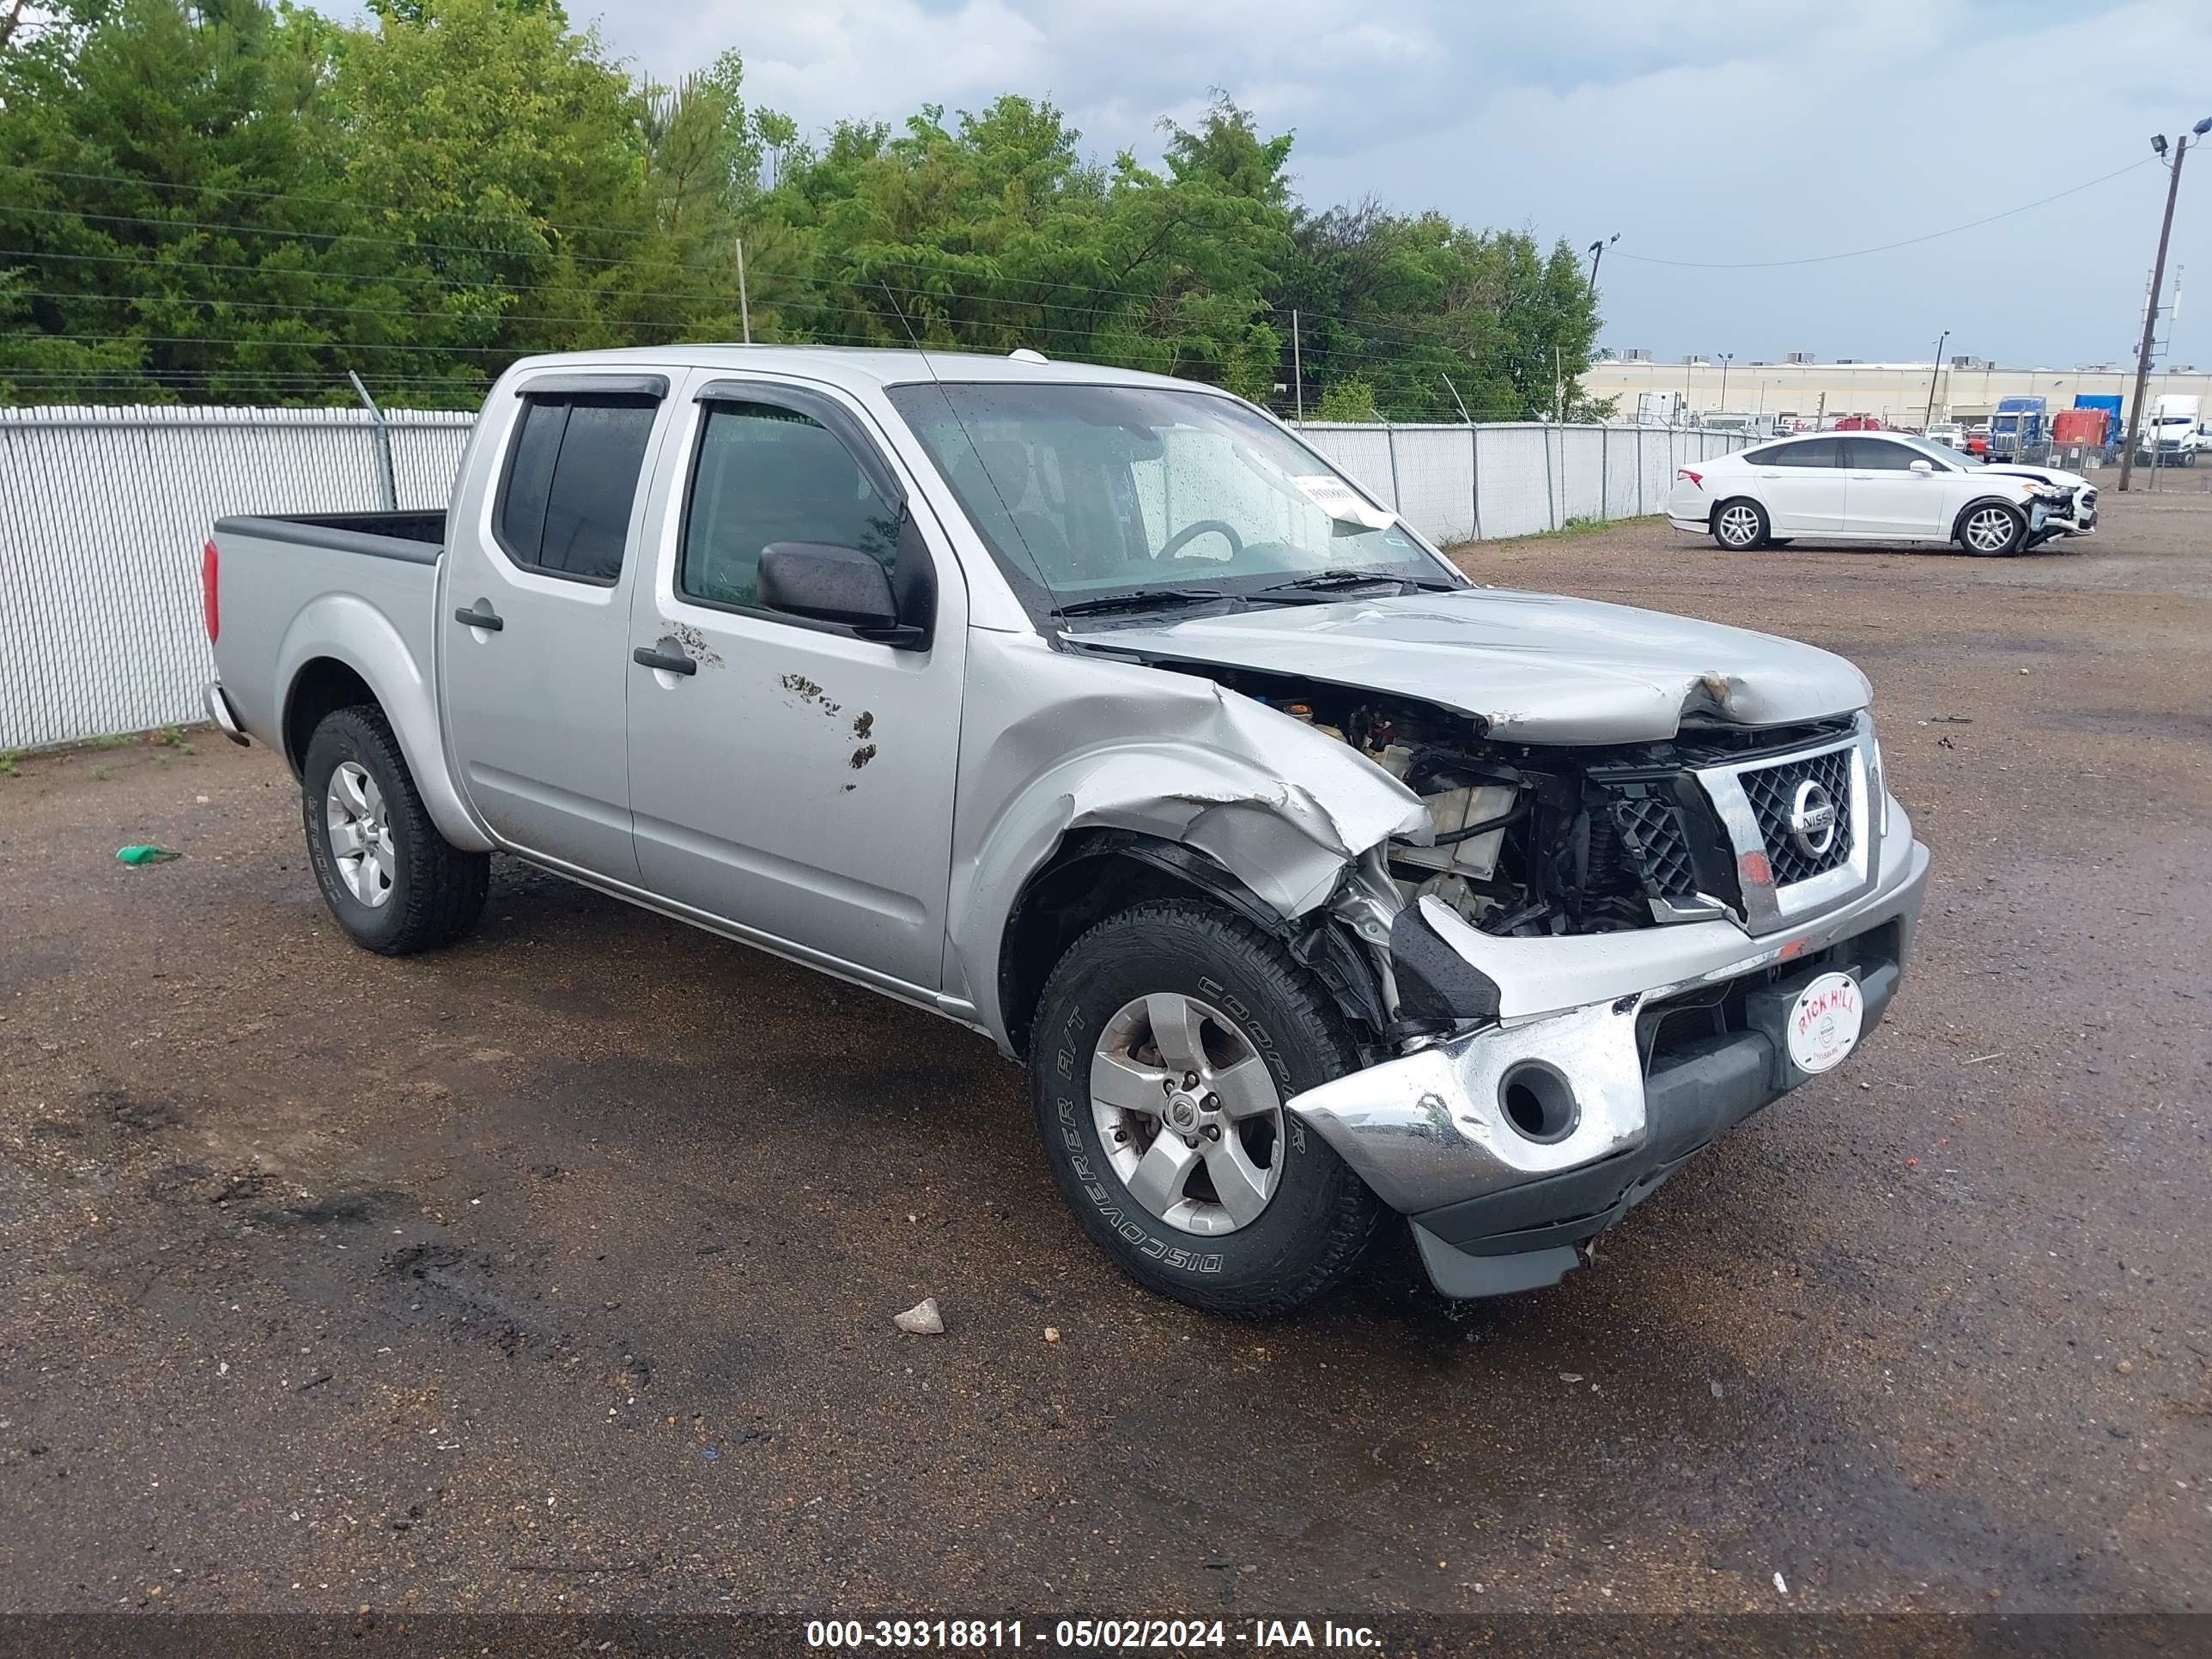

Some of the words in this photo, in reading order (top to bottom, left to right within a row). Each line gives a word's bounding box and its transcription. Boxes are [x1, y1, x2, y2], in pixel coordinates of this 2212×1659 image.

[307, 796, 342, 904] COOPER
[1057, 1005, 1086, 1082] A/T
[1799, 994, 1827, 1035] RICK
[1831, 989, 1853, 1012] HILL
[1056, 1098, 1224, 1274] DISCOVERER
